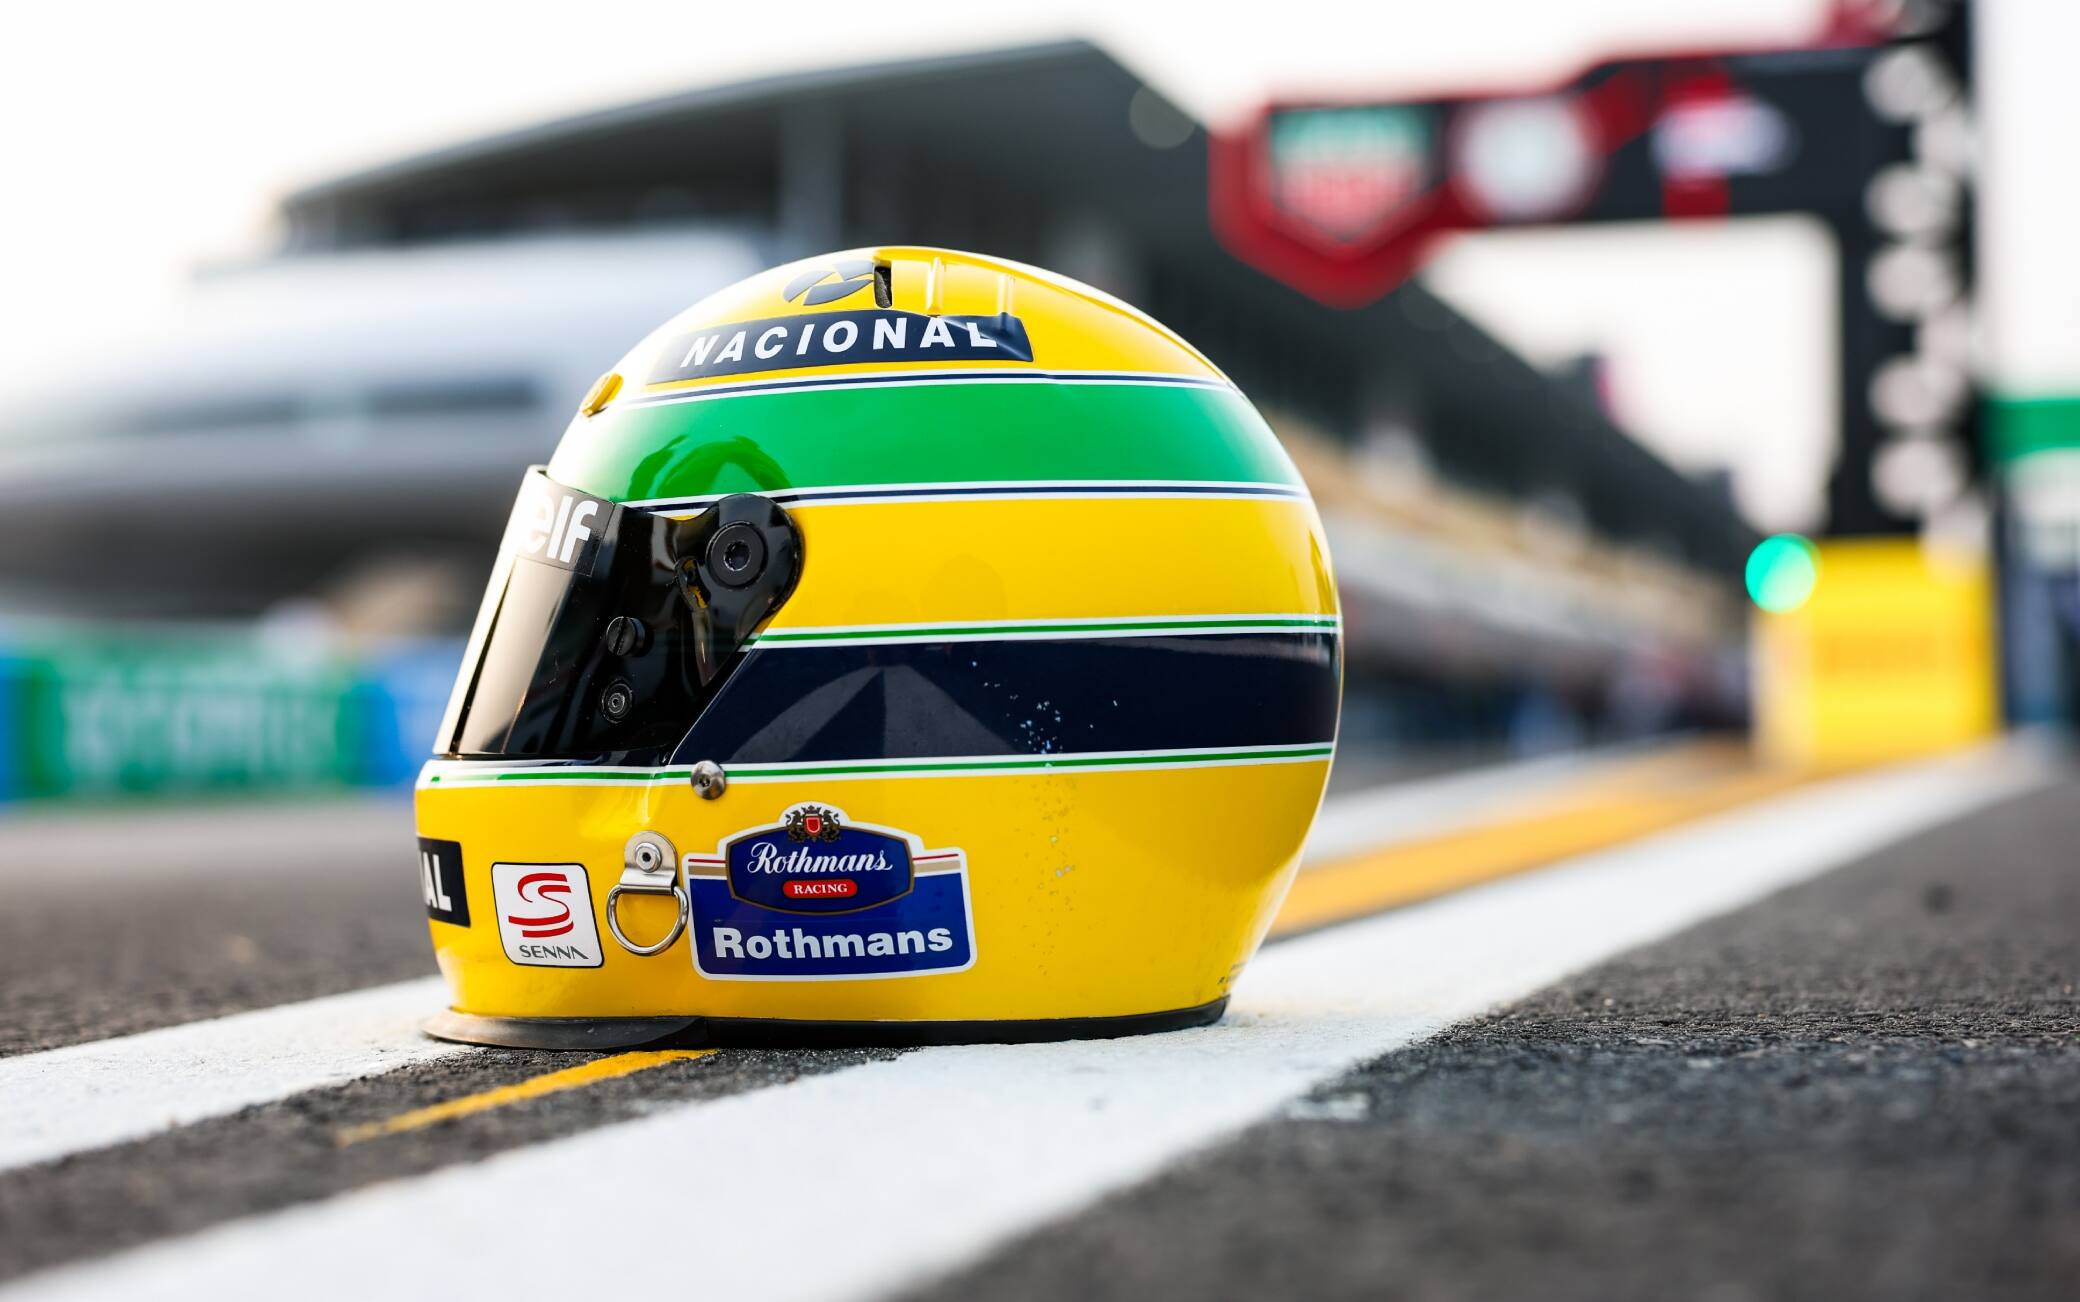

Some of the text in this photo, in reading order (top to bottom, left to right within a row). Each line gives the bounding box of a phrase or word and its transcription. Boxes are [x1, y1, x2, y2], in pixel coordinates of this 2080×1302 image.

[680, 317, 997, 369] NACIONAL
[523, 495, 599, 563] elf
[747, 841, 893, 874] Rothmans
[419, 850, 453, 912] AL
[793, 882, 847, 894] RACING
[519, 944, 589, 960] SENNA
[713, 927, 953, 960] Rothmans
